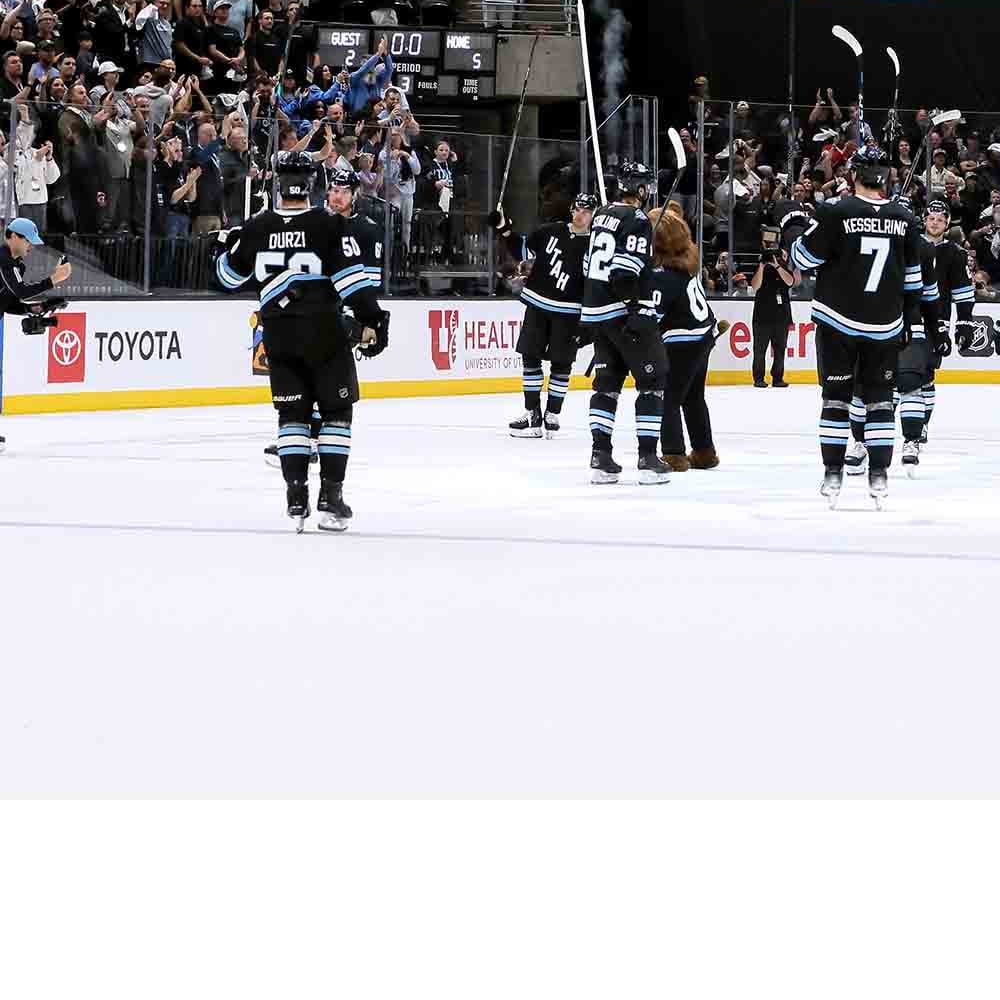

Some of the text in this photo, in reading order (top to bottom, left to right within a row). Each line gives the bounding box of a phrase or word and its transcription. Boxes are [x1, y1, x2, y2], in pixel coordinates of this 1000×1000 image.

[331, 32, 361, 46] GUEST
[447, 35, 471, 49] HOME
[392, 63, 421, 73] PERIOD
[842, 217, 908, 236] KESSELRING
[269, 231, 306, 249] DURZI
[626, 235, 648, 254] 82
[545, 236, 571, 291] UTAH
[860, 236, 890, 292] 7
[465, 321, 523, 350] HEALT
[95, 331, 182, 361] TOYOTA
[465, 357, 501, 370] UNIVERSITY
[503, 357, 512, 368] OF
